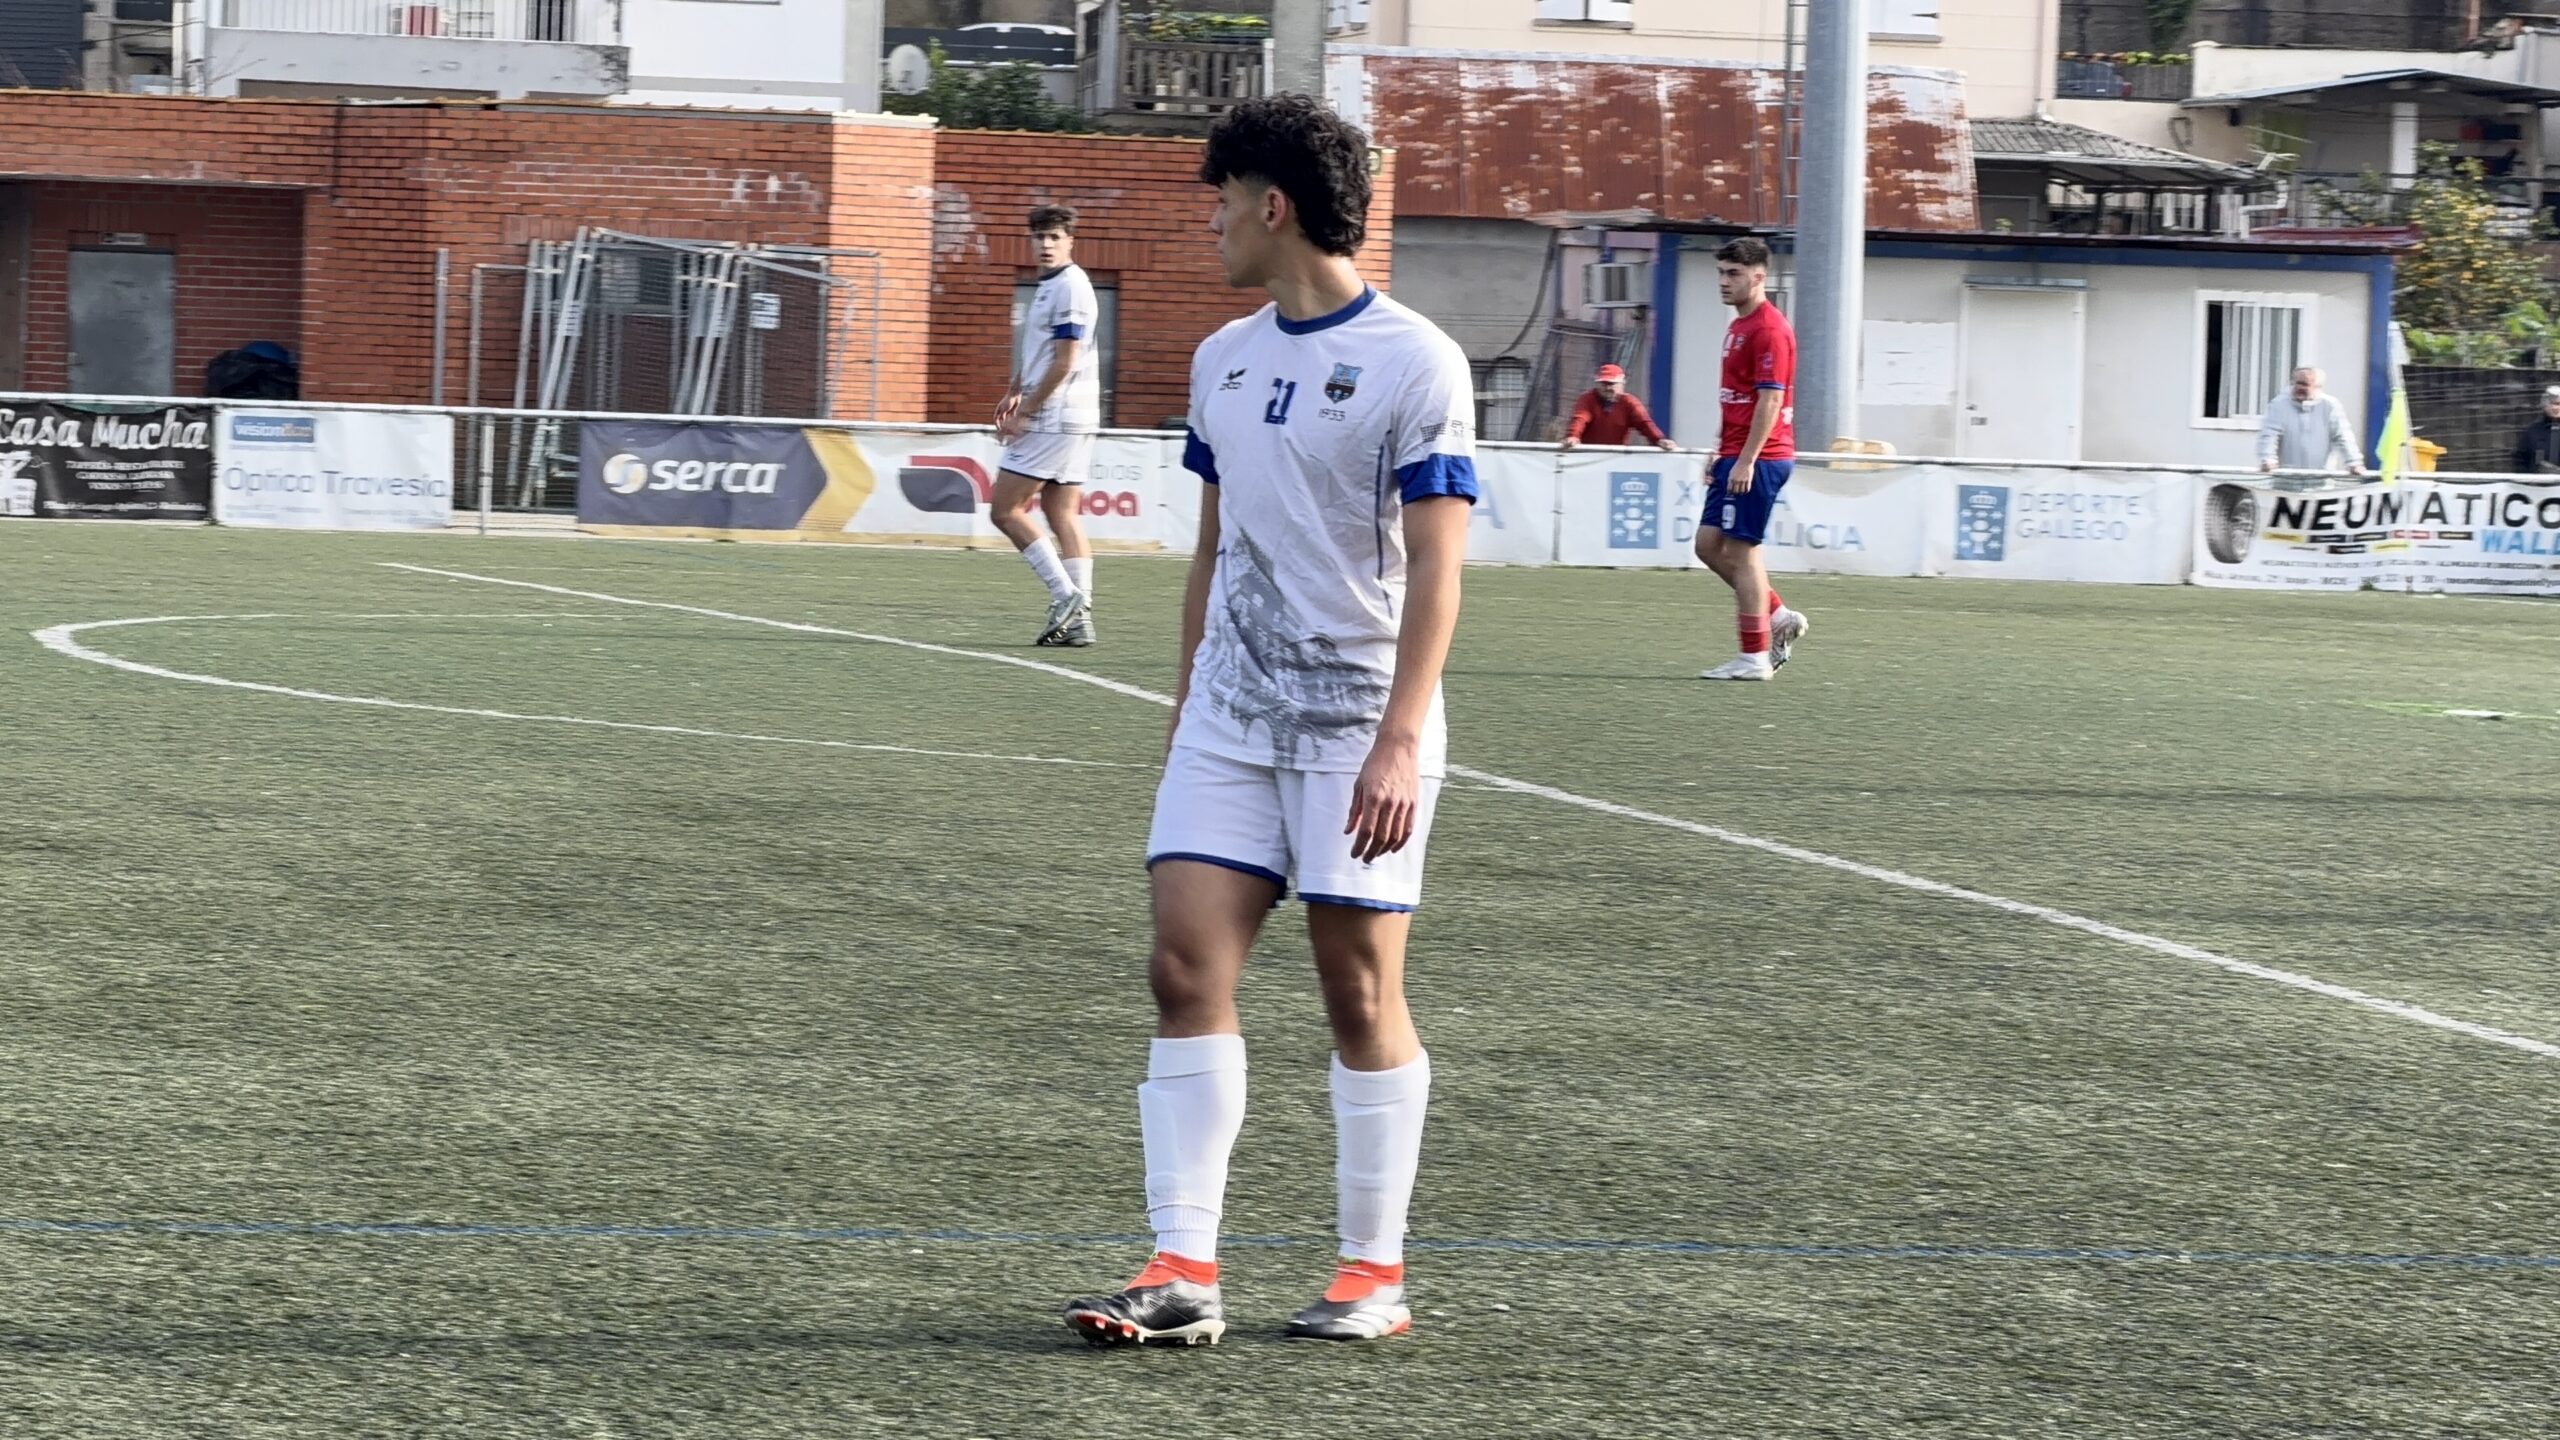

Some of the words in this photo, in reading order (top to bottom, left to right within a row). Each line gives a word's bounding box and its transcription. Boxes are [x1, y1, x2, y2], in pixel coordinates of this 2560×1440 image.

[1263, 377, 1297, 425] 21
[91, 409, 210, 450] Mucha
[648, 459, 788, 494] serca
[1722, 503, 1737, 530] 9
[2018, 492, 2142, 516] DEPORTE
[2015, 518, 2128, 541] GALEGO
